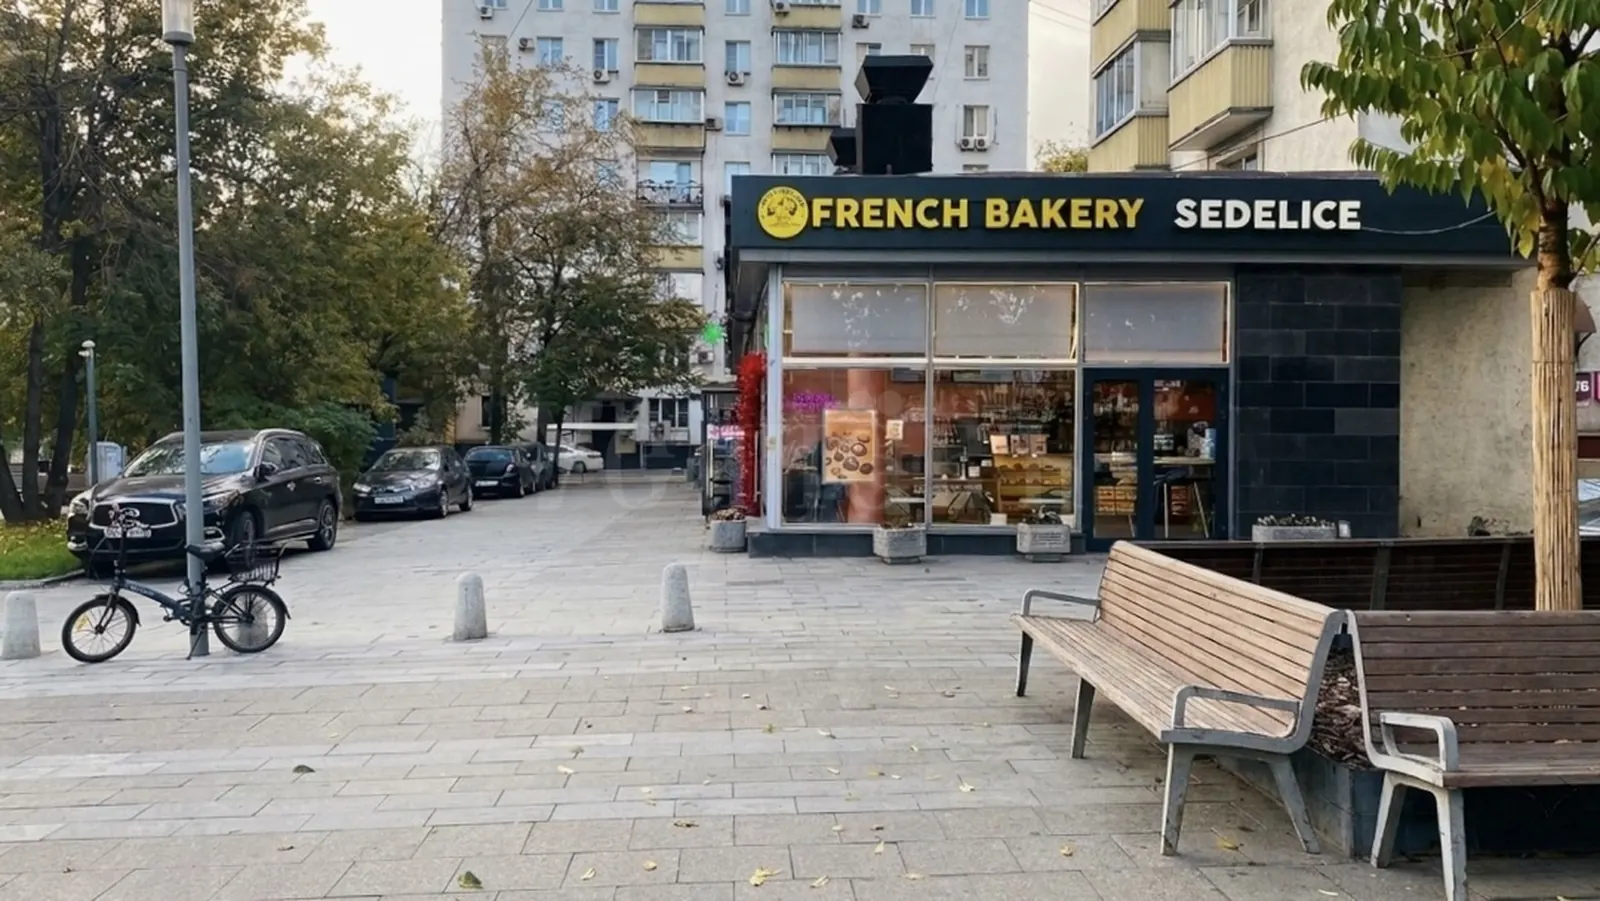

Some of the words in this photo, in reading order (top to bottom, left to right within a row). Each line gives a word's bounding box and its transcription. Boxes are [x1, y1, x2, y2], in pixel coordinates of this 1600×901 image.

[812, 197, 969, 229] FRENCH
[985, 197, 1145, 229] BAKERY
[1174, 198, 1362, 230] SEDELICE
